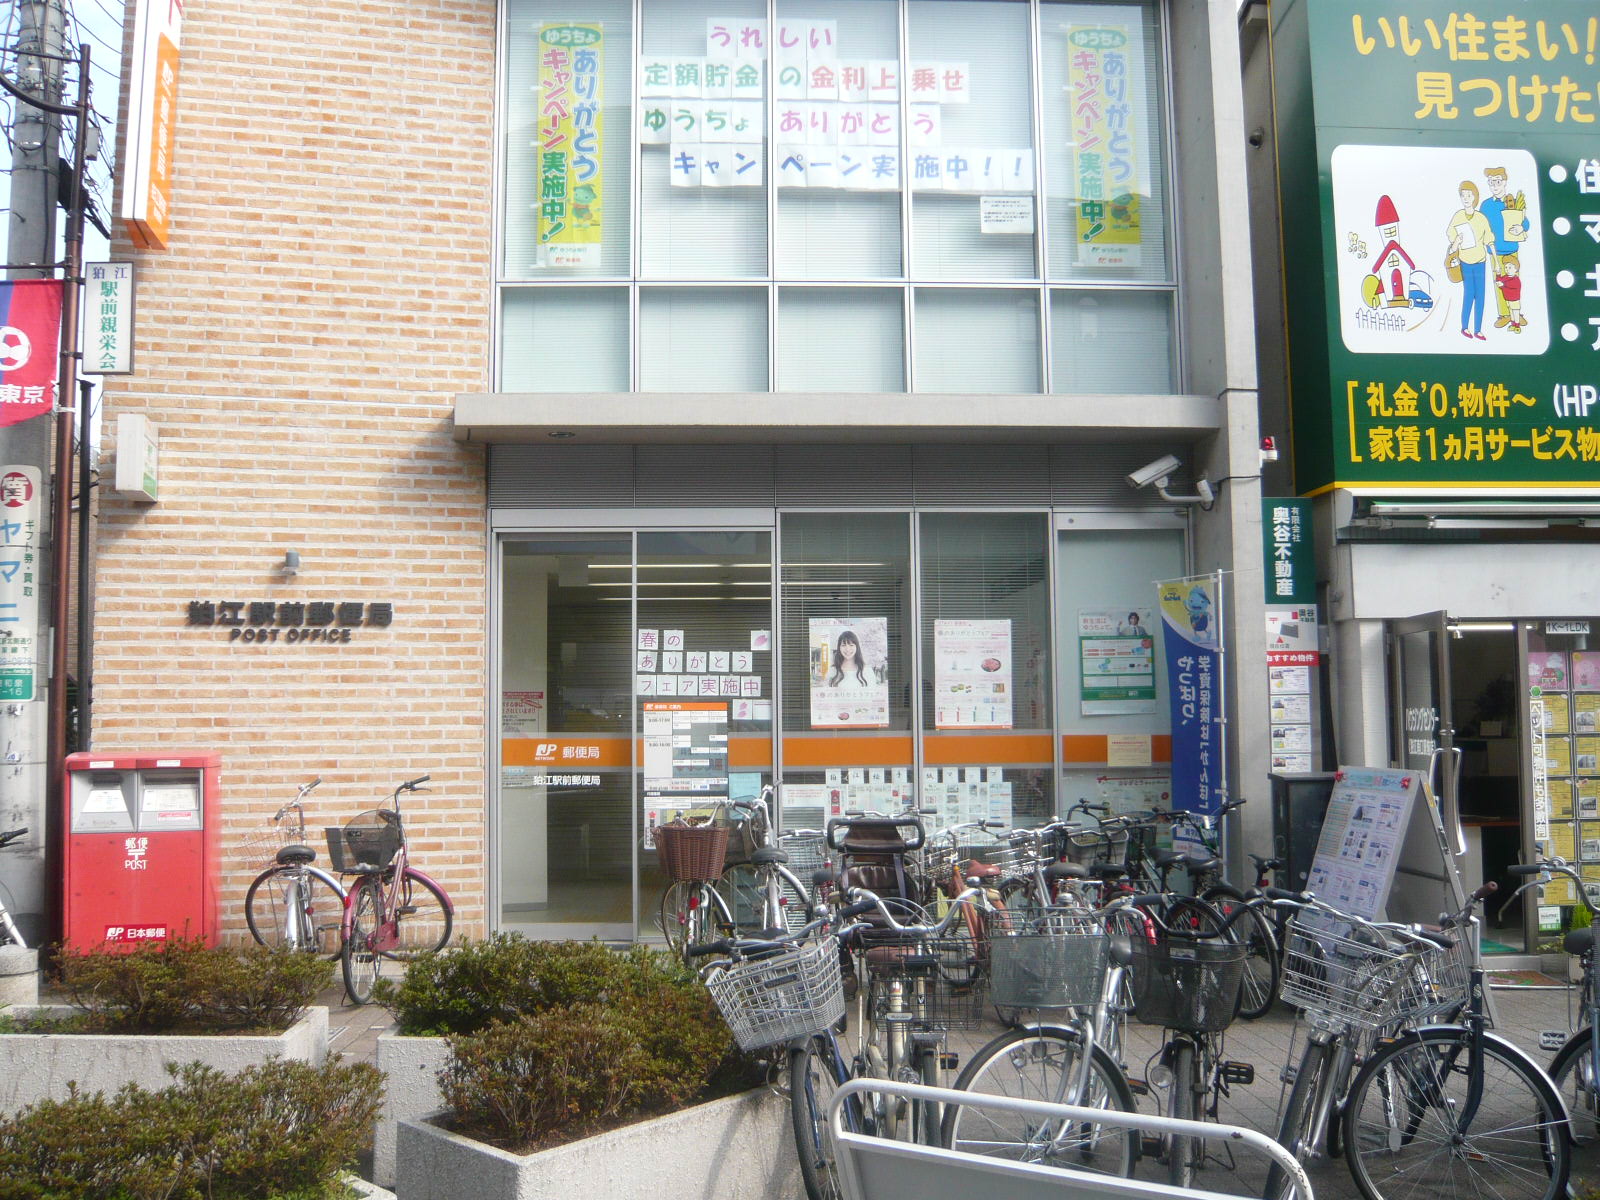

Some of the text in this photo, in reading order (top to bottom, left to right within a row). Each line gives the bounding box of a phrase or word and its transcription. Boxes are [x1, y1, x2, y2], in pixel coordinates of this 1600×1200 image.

[545, 29, 596, 44] ゆうちょ
[709, 25, 833, 49] うれしい
[1074, 31, 1123, 46] ゆうちょ
[1414, 71, 1600, 123] 見つけた
[572, 50, 599, 182] ありがとう
[1102, 52, 1132, 181] ありがとう
[93, 267, 128, 279] 狛江
[99, 280, 118, 370] 駅前親栄会
[1290, 506, 1301, 542] 有限会社
[1272, 506, 1294, 596] 奥谷不動産
[231, 629, 352, 643] POST OFFICE
[641, 631, 681, 648] 春の
[641, 655, 748, 669] ありがとう
[641, 678, 760, 695] フェア実施中
[562, 746, 600, 759] 郵便局
[533, 774, 601, 786] 狛江駅前郵便局
[125, 837, 149, 849] 郵便
[124, 860, 148, 870] POST
[127, 927, 166, 939] 日本郵便
